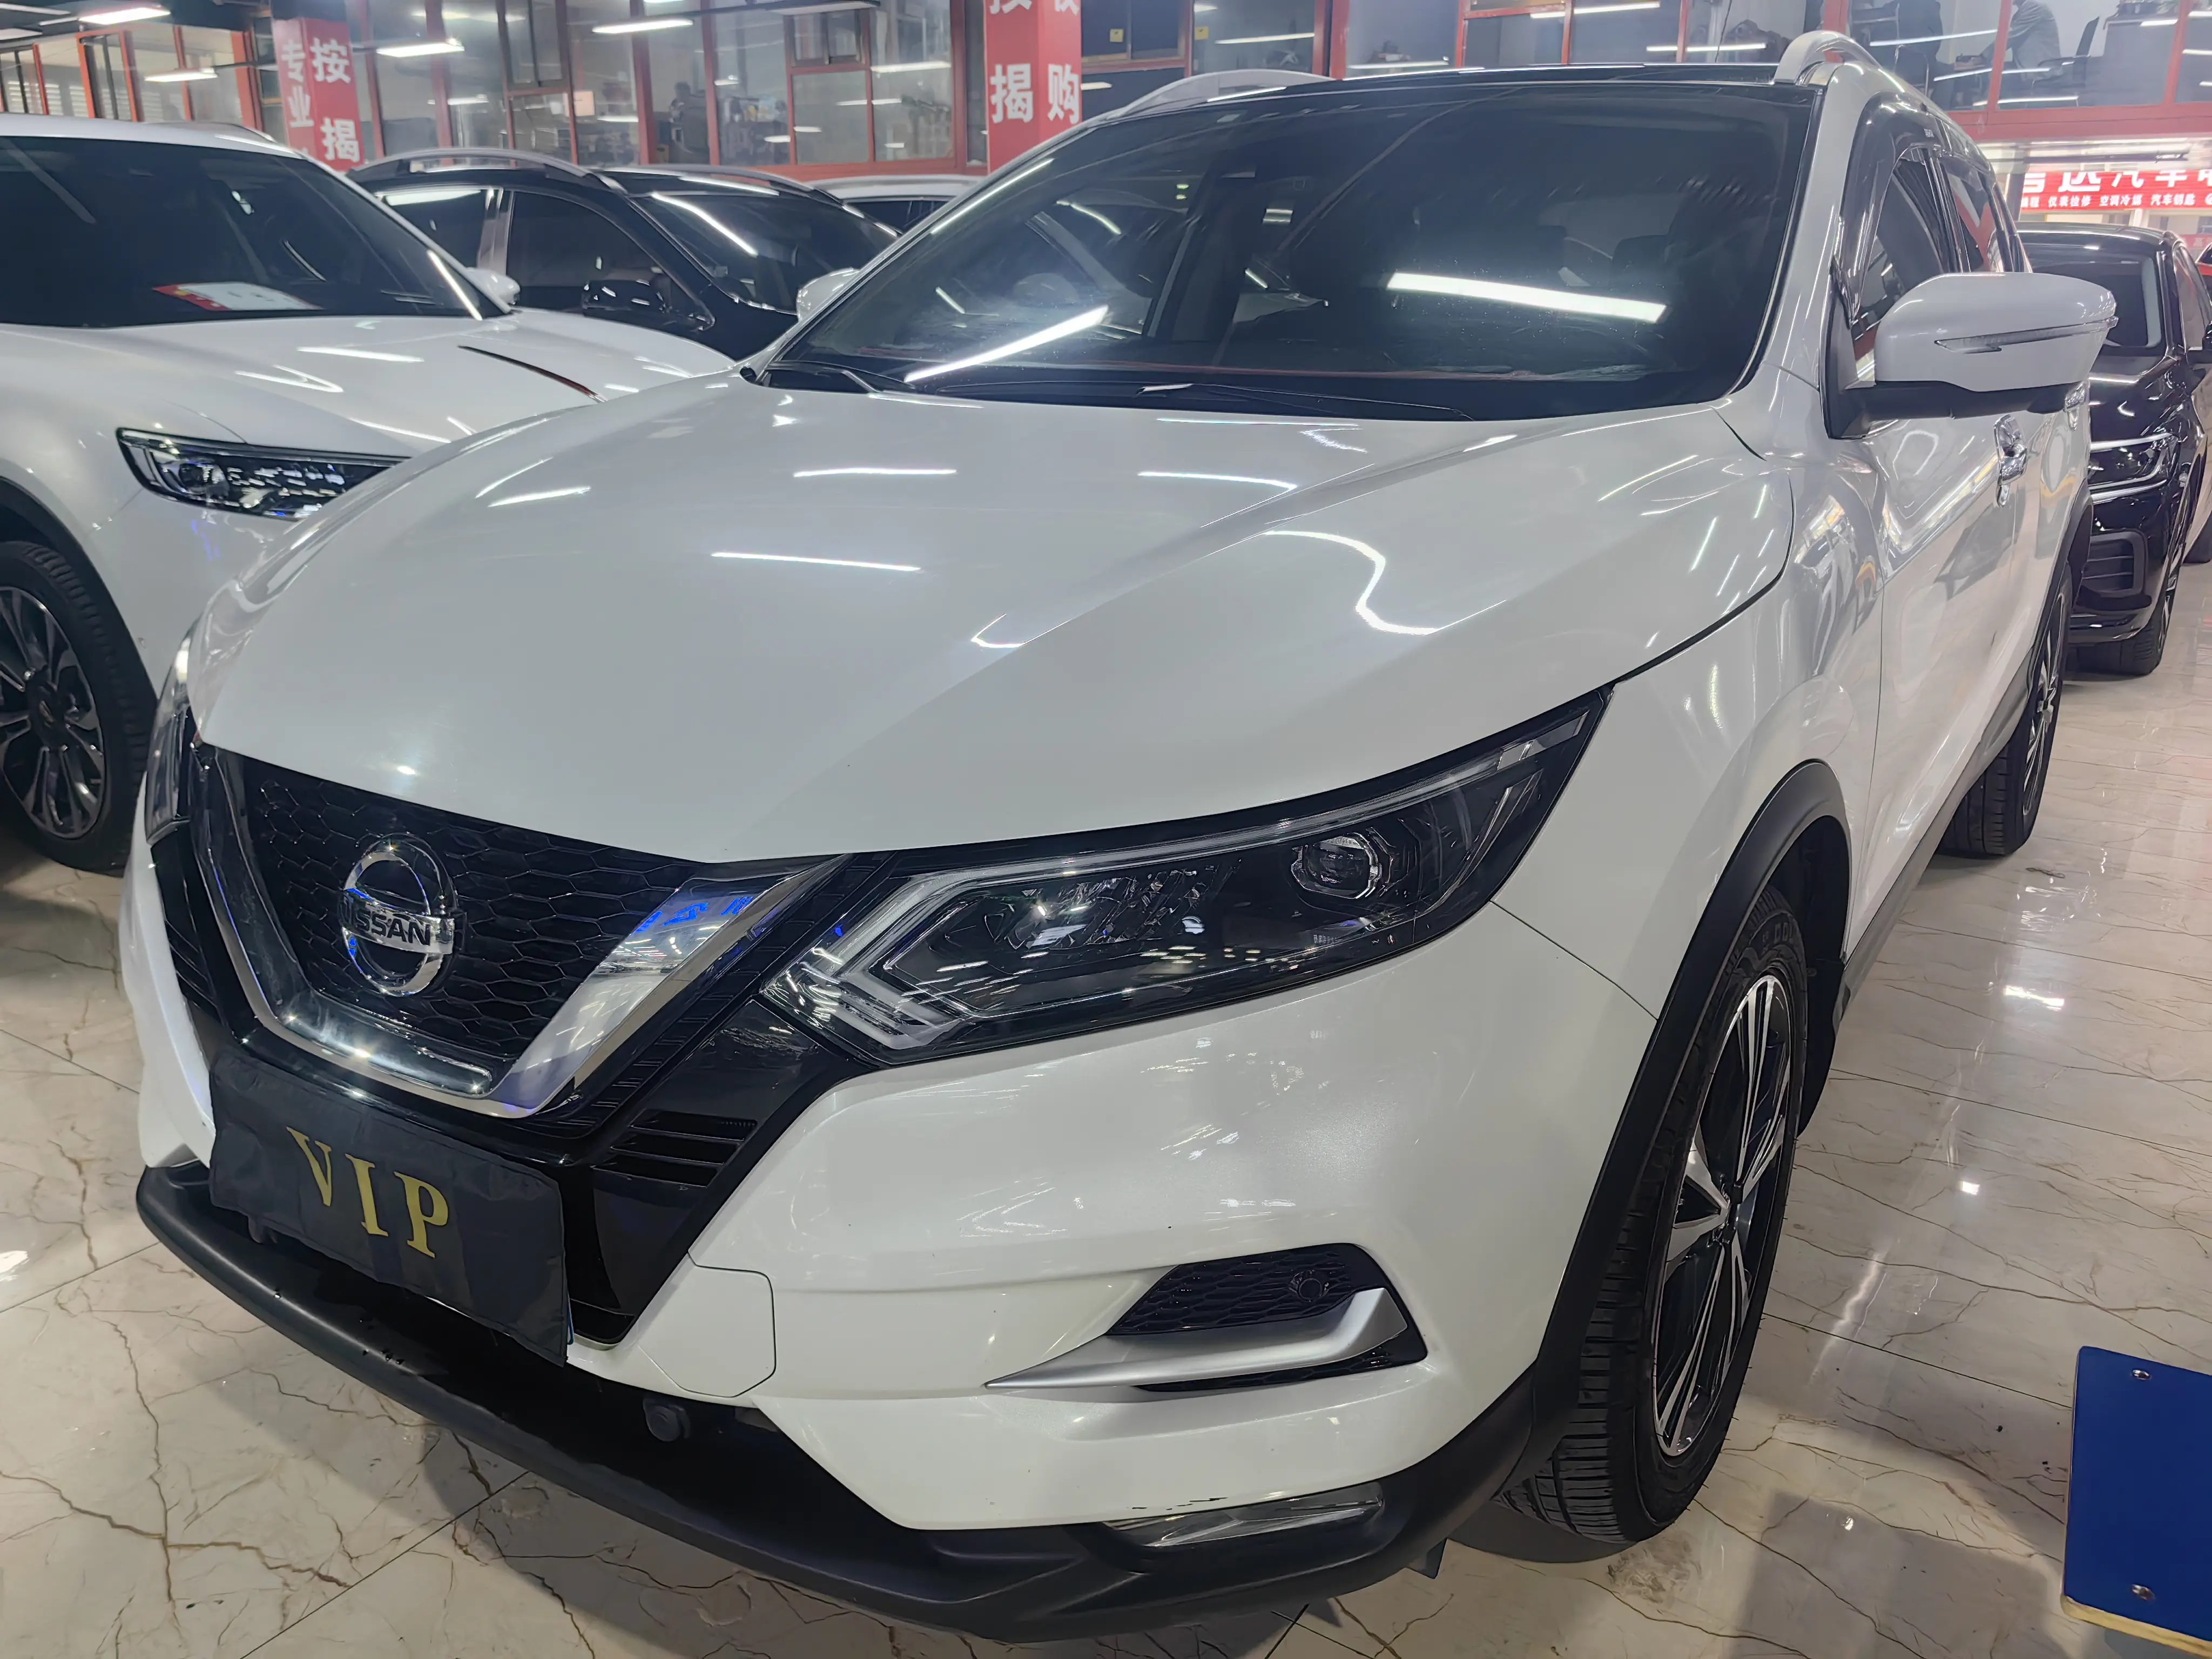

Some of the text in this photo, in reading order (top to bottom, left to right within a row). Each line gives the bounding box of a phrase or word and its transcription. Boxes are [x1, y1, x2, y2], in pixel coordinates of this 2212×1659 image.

[281, 39, 315, 157] 专业
[309, 37, 360, 163] 按揭
[989, 0, 1033, 124] 揭
[1047, 0, 1080, 124] 购
[340, 896, 431, 946] NISSAN
[286, 1126, 449, 1258] VIP
